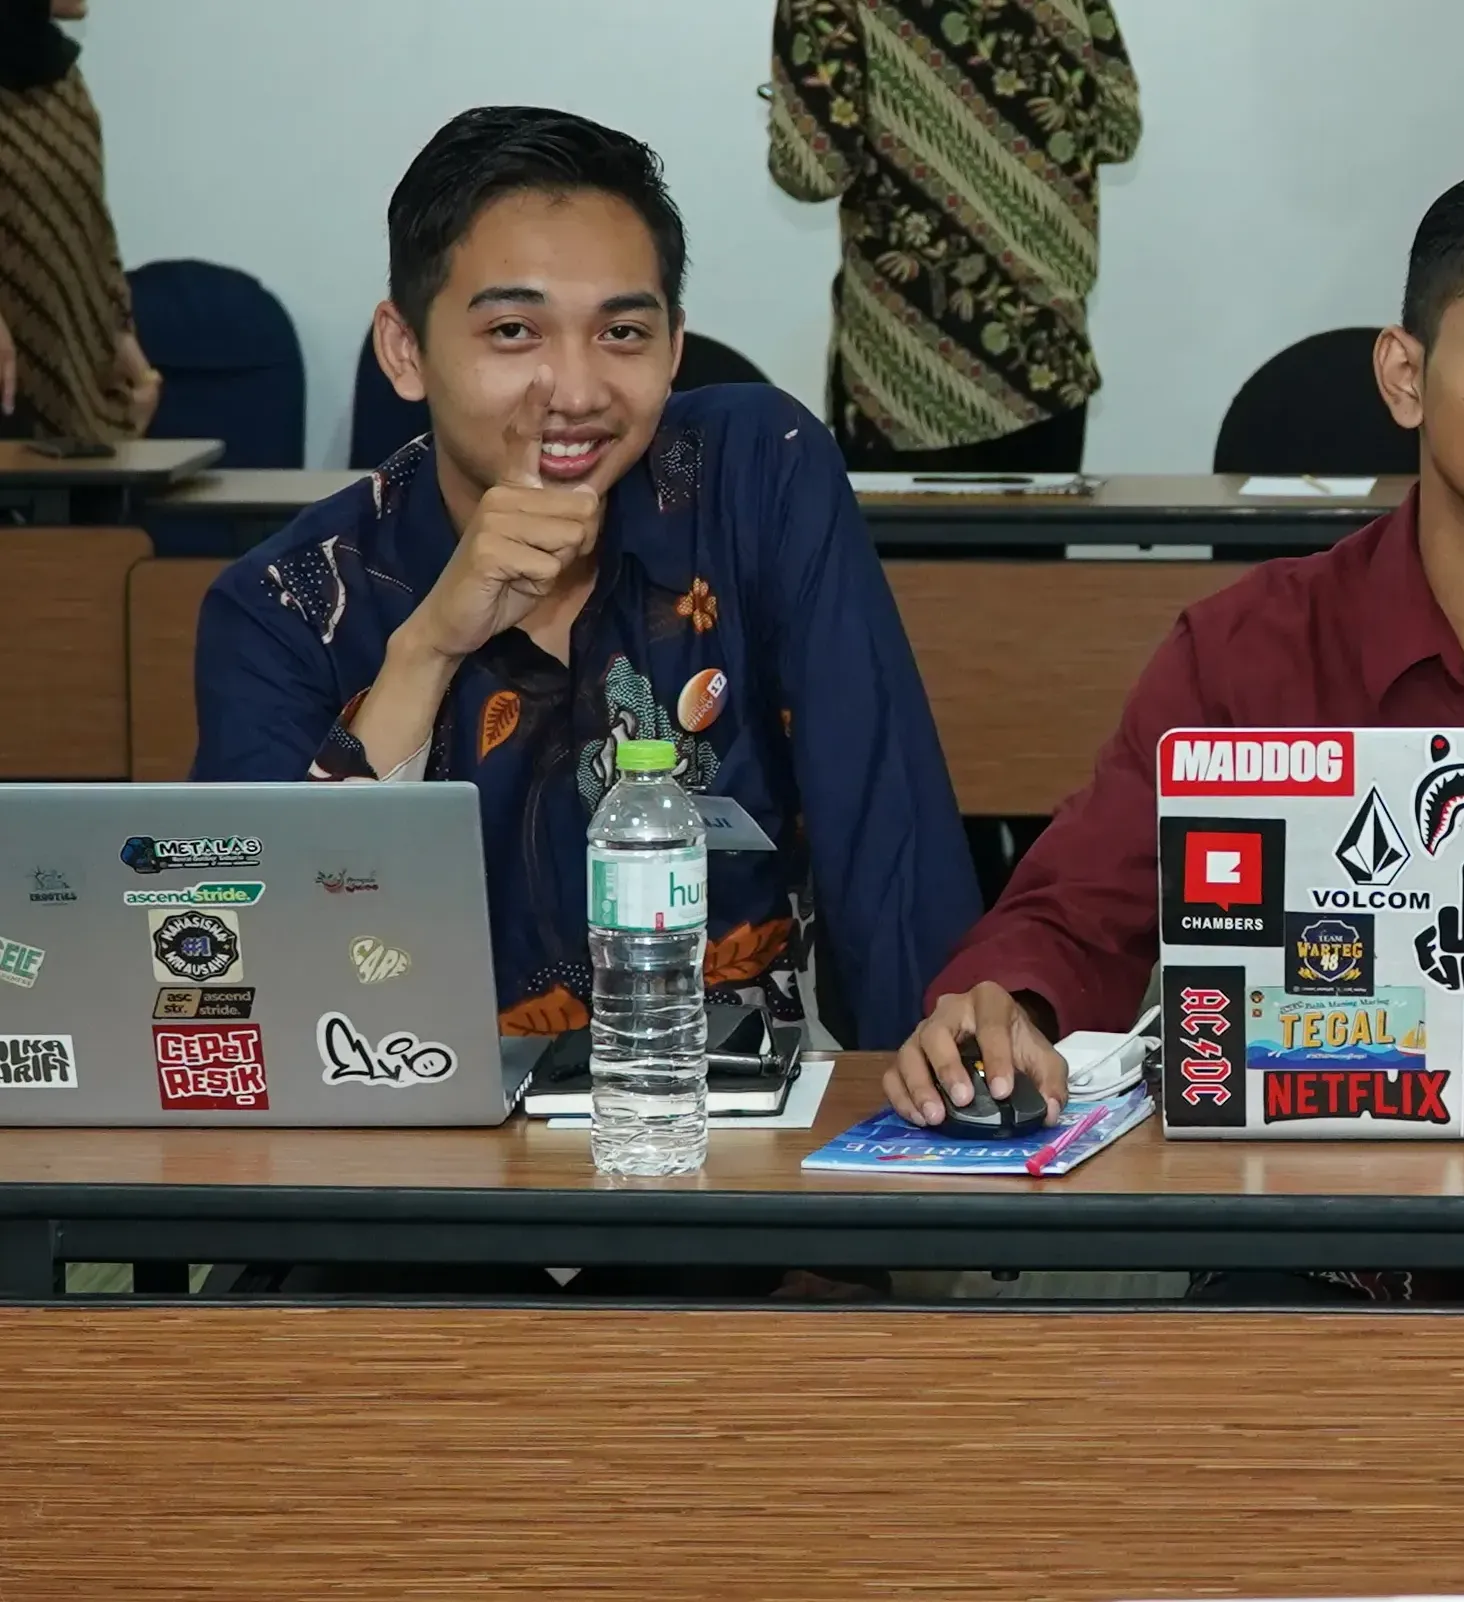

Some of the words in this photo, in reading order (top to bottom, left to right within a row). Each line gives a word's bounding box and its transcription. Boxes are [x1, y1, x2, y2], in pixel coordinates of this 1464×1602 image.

[1171, 740, 1344, 783] MADDOG
[159, 837, 259, 855] METALAS
[669, 871, 707, 907] hur
[1312, 891, 1430, 909] VOLCOM
[1182, 917, 1264, 931] CHAMBERS
[181, 936, 212, 957] #1
[1296, 941, 1363, 959] WARTEG
[165, 951, 230, 975] WIRAUSAHA
[167, 993, 192, 1002] asc
[203, 991, 251, 1002] ascend
[200, 1005, 241, 1016] stride.
[1279, 1009, 1396, 1050] TEGAL
[1267, 1073, 1446, 1118] NETFLIX
[842, 1142, 1043, 1158] APERLINE
